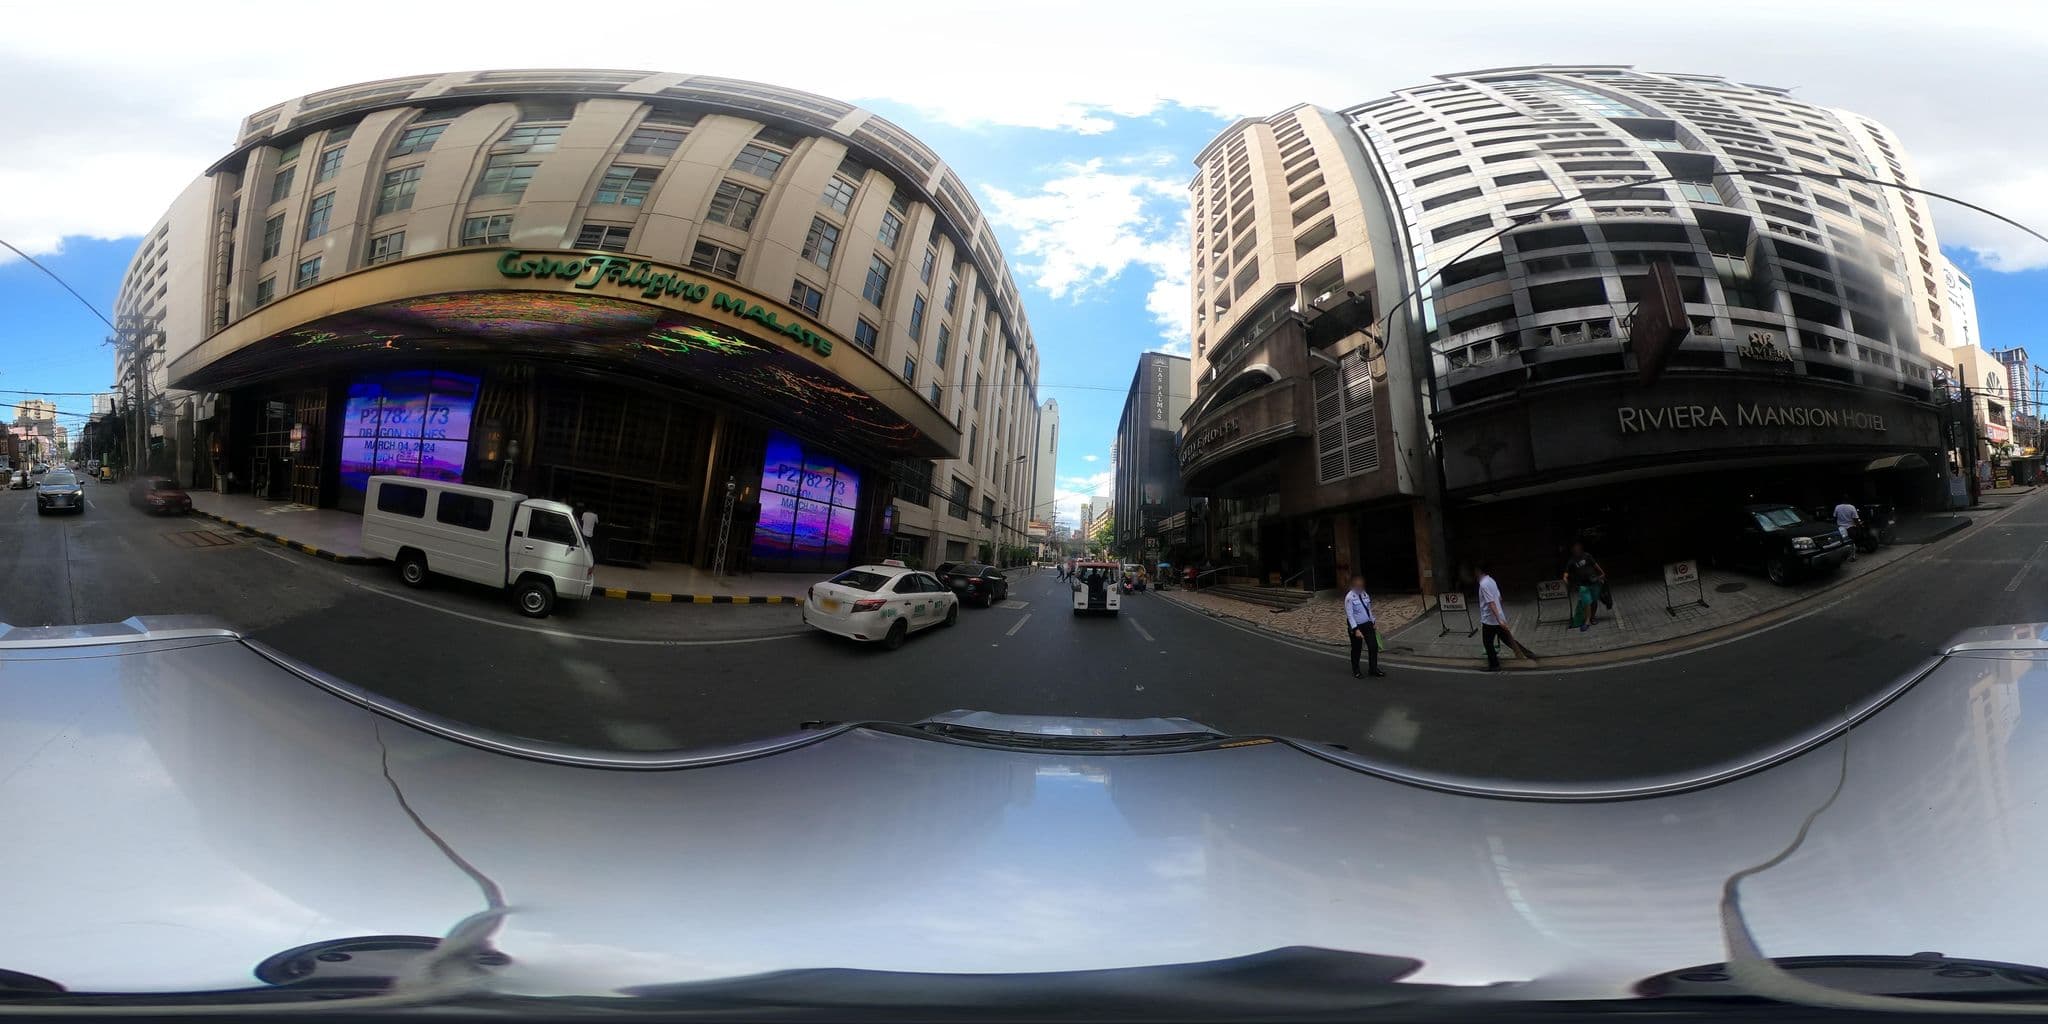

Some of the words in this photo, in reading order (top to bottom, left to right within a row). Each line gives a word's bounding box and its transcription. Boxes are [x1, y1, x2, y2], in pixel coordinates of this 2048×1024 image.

[575, 255, 710, 304] Filipino
[713, 291, 833, 357] MALATE
[1736, 344, 1793, 362] RIVIERA
[1618, 406, 1728, 433] RIVIERA
[1737, 403, 1838, 427] MANSION
[1842, 408, 1887, 432] HOTEL
[775, 483, 814, 499] DRAON
